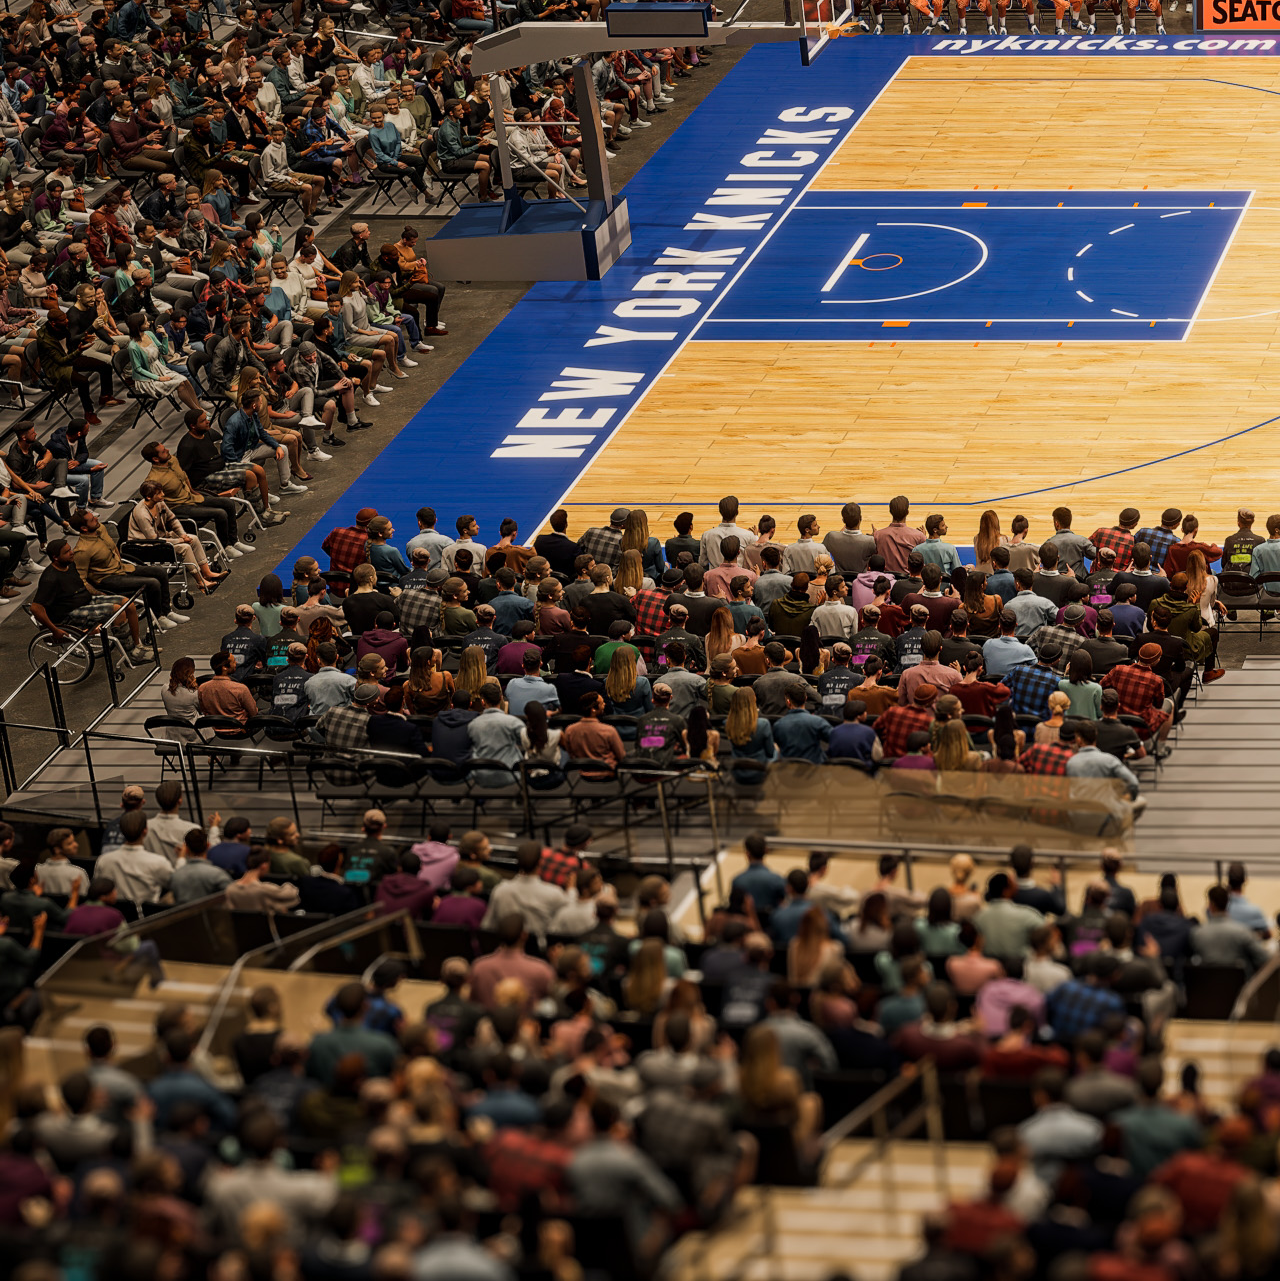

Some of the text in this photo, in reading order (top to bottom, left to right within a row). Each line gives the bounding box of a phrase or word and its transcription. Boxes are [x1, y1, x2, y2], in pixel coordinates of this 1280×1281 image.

[931, 35, 1277, 55] nyknicks.com
[489, 106, 855, 458] NEW YORK KNICKS
